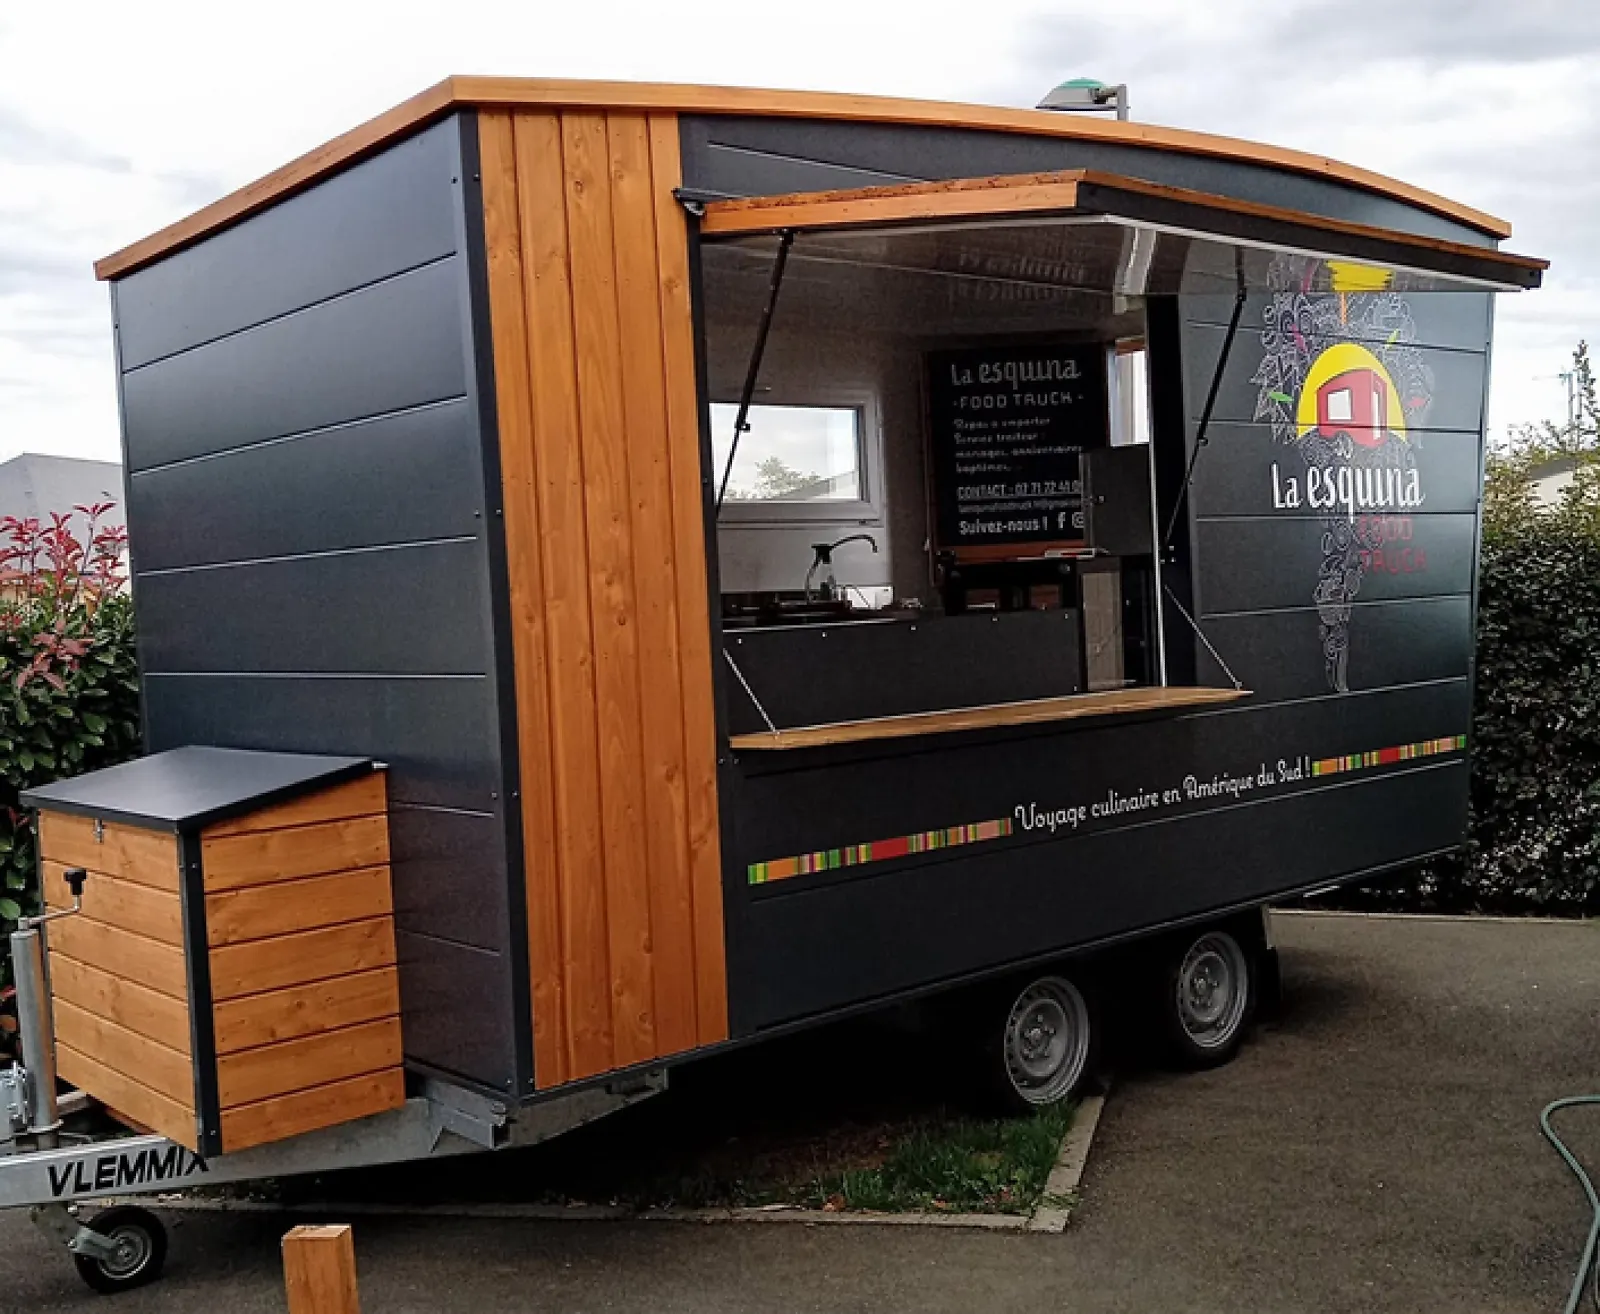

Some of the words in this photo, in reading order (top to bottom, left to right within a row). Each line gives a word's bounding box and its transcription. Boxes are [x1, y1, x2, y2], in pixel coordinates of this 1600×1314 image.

[952, 363, 973, 385] La
[979, 359, 1082, 390] esquina
[960, 394, 1007, 410] FOOD
[1013, 391, 1073, 407] TRUCK
[1271, 463, 1303, 509] La
[1307, 466, 1426, 524] esquina
[1358, 516, 1413, 542] FOOD
[1360, 547, 1427, 574] TRUCK
[1014, 802, 1086, 833] Voyage
[1092, 787, 1158, 818] culinaire
[1162, 788, 1181, 805] en
[1257, 762, 1275, 787] du
[47, 1145, 209, 1197] VLEMMIX
